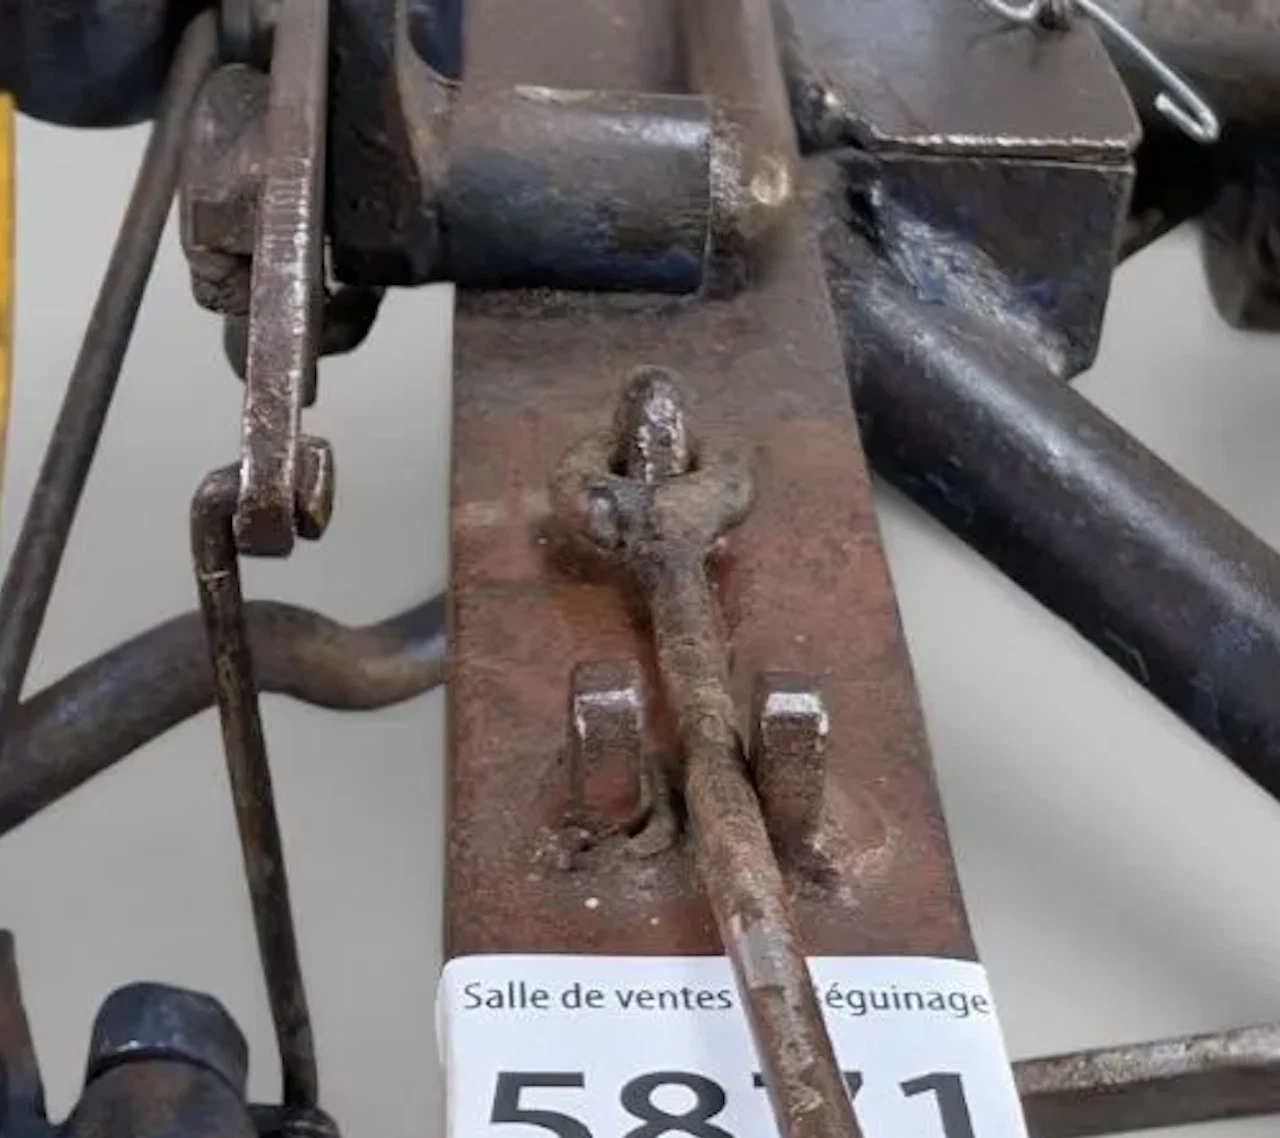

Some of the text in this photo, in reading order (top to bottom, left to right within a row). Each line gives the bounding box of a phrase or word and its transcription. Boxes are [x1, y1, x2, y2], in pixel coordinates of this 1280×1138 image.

[463, 980, 989, 1019] Salle de ventes éguinage
